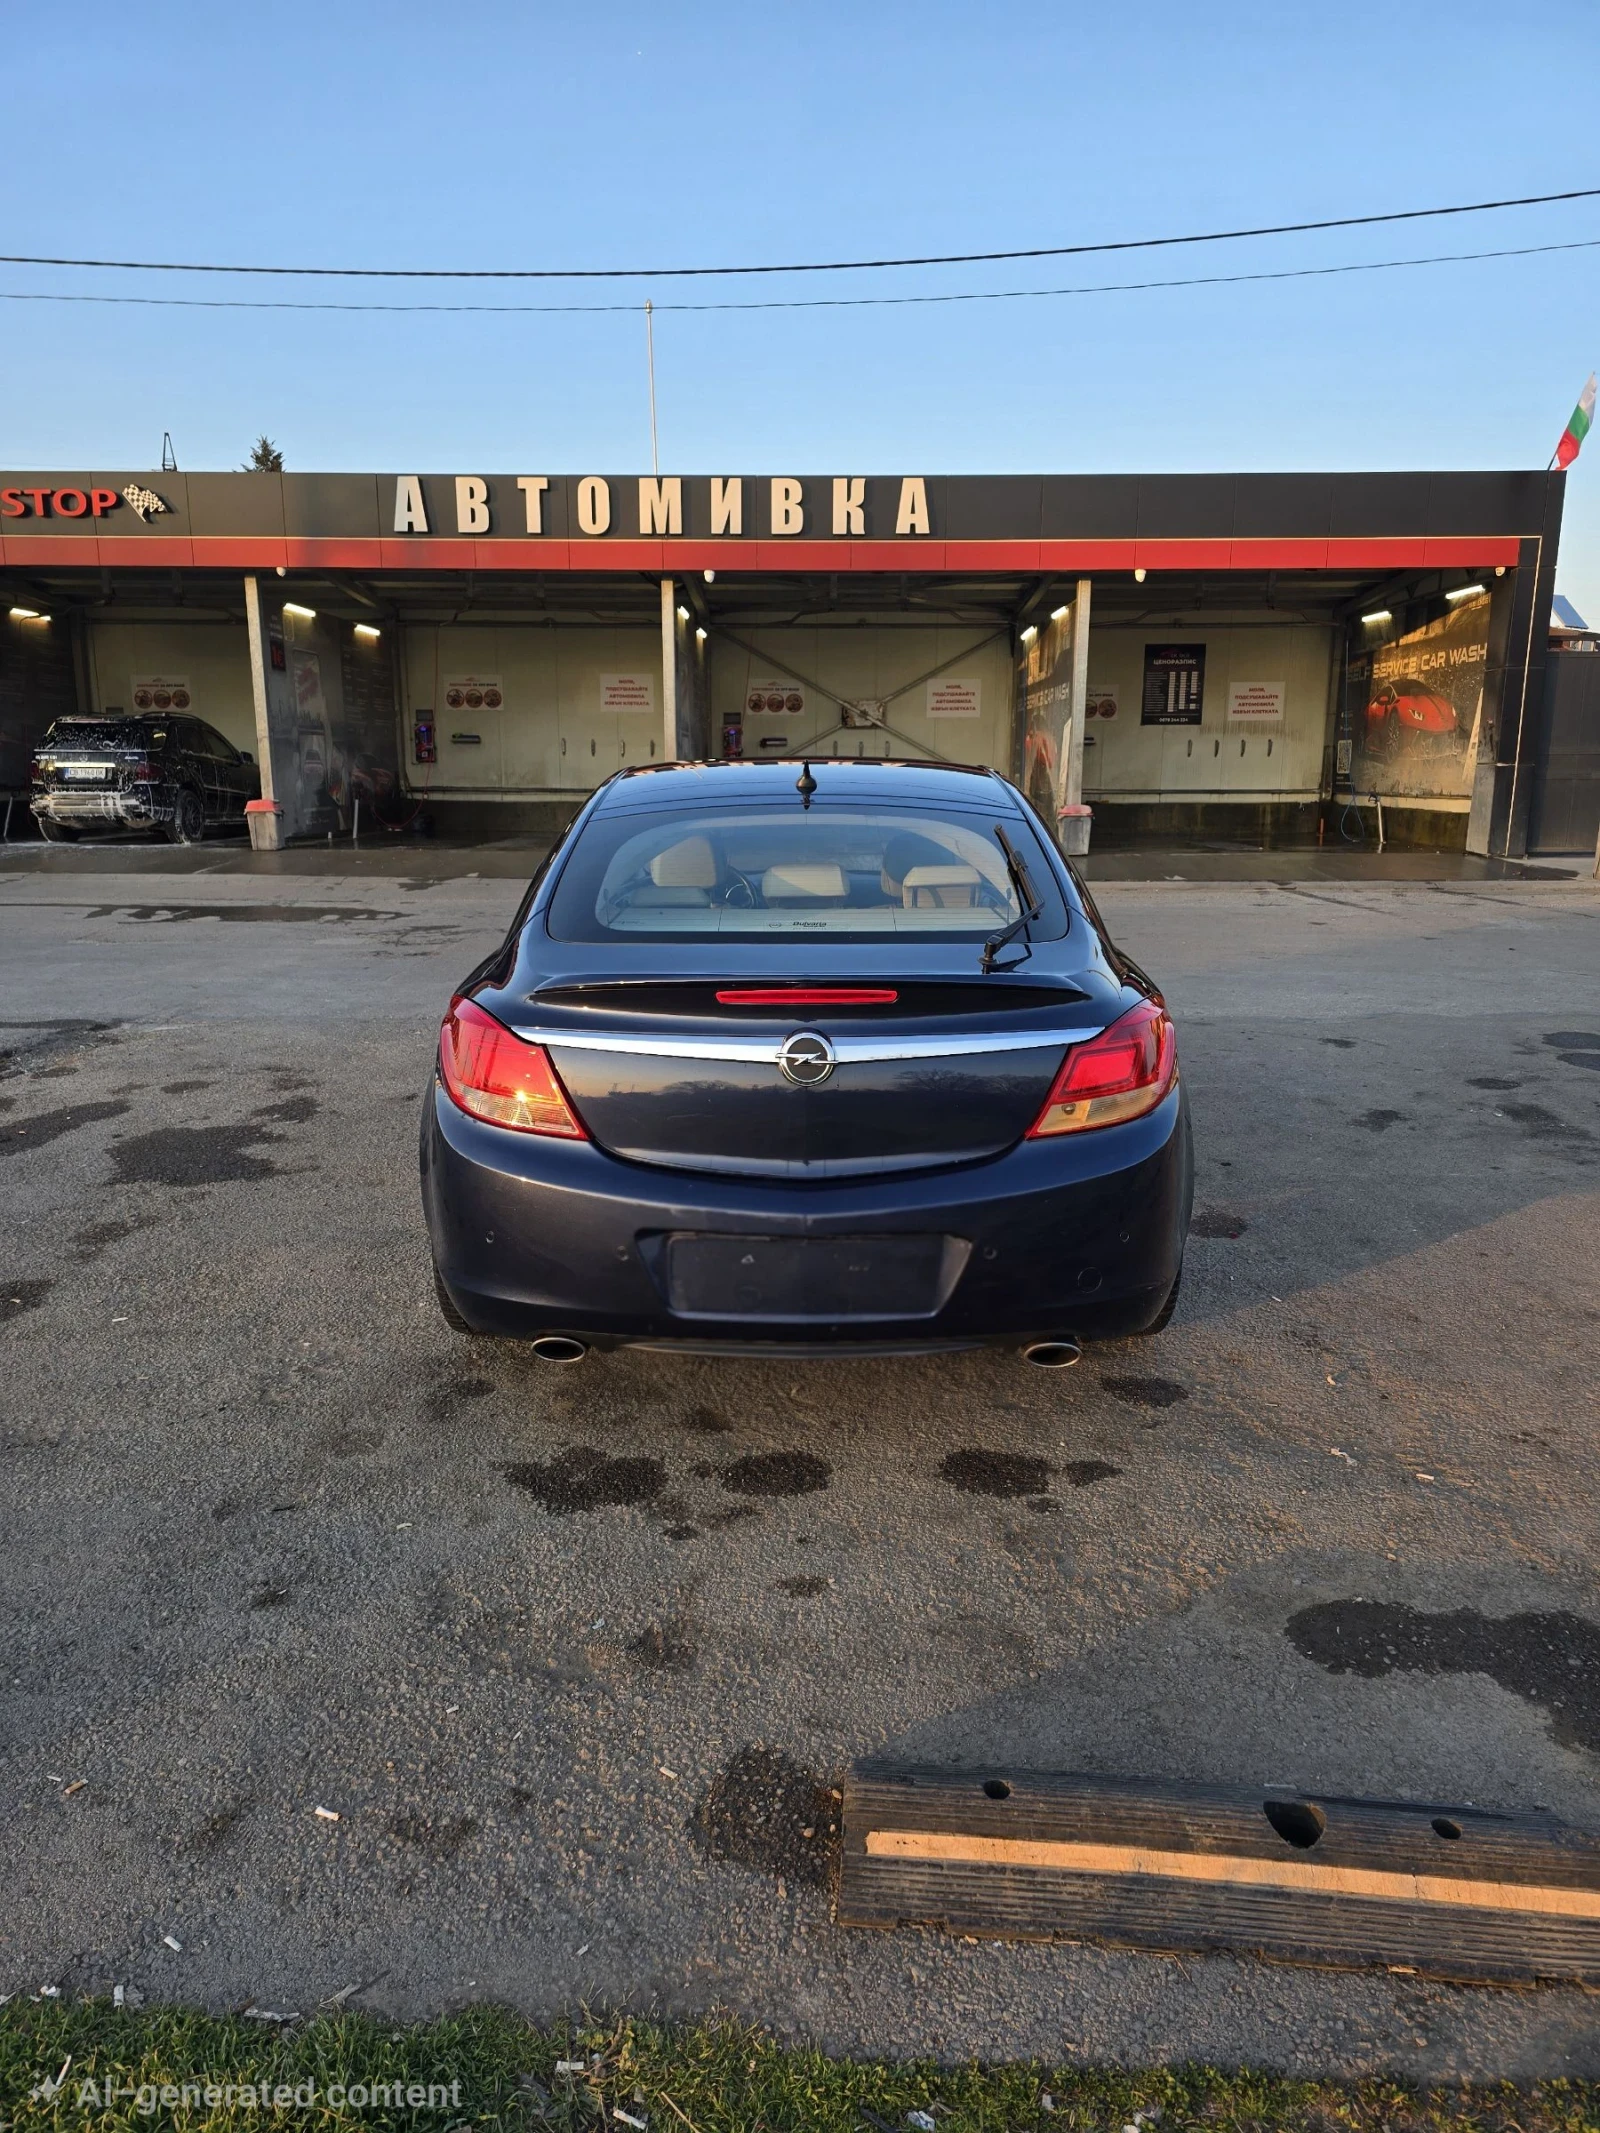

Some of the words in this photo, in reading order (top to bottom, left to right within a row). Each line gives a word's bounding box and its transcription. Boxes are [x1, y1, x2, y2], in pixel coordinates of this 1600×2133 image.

[1, 488, 118, 518] STOP
[394, 476, 931, 536] АВТОМИВКА
[1373, 656, 1417, 679] SERVICE
[1421, 651, 1445, 671] CAR
[1450, 642, 1488, 666] WASH
